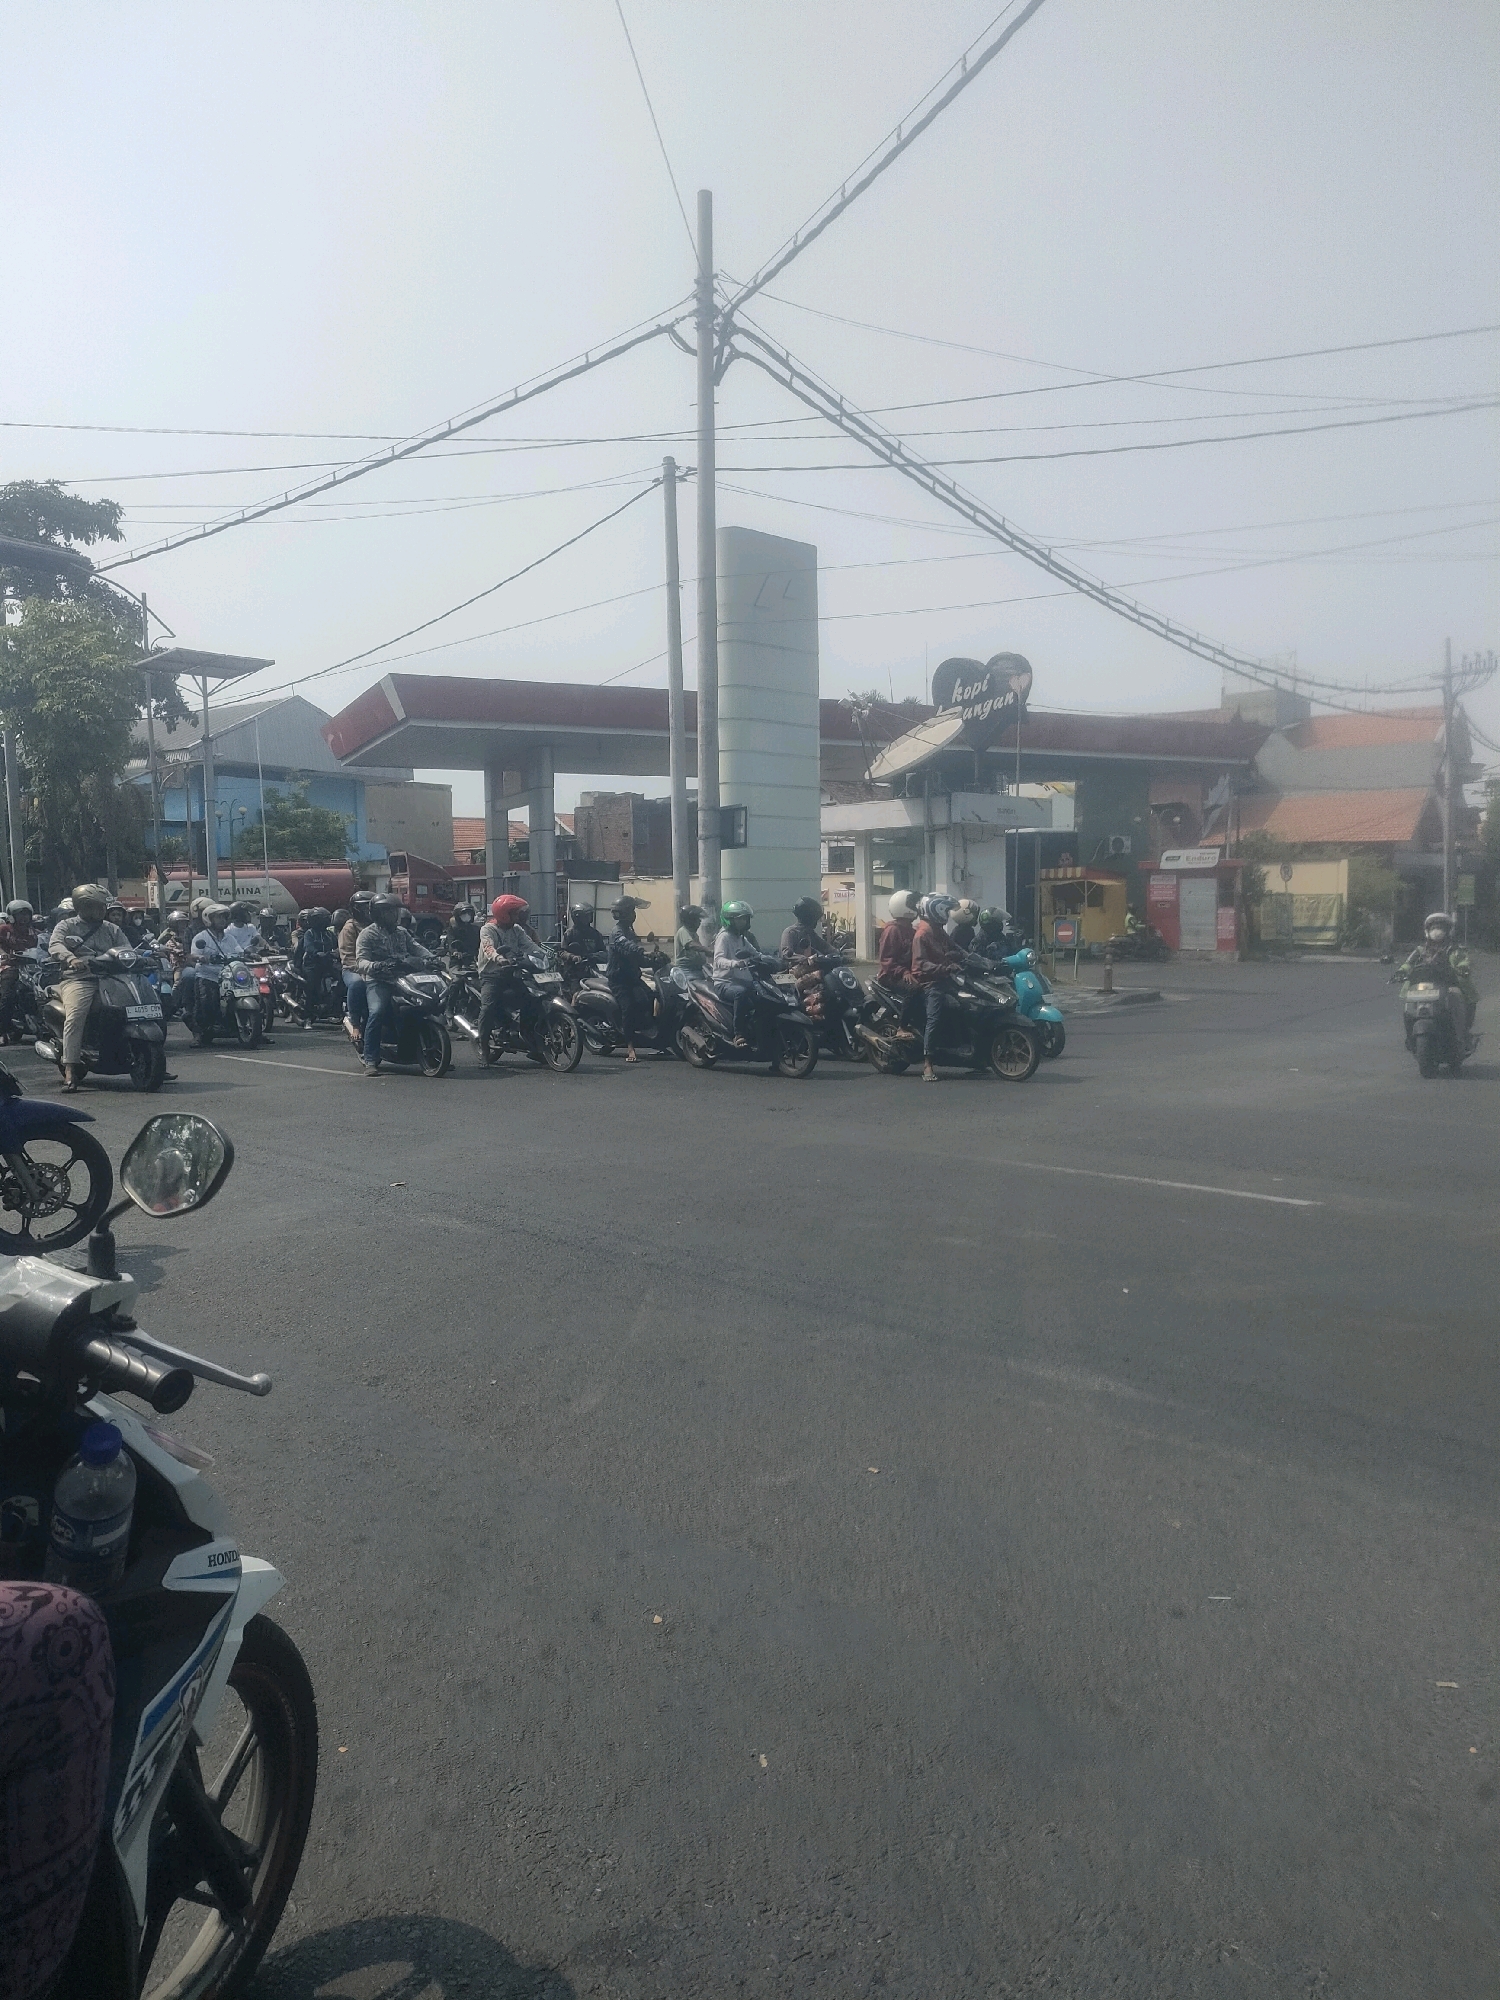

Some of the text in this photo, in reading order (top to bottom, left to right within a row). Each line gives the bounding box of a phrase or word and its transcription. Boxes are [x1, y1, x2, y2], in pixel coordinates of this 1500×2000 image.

[951, 673, 991, 704] kopi
[936, 691, 1014, 721] angan
[198, 887, 261, 897] PTAMINA
